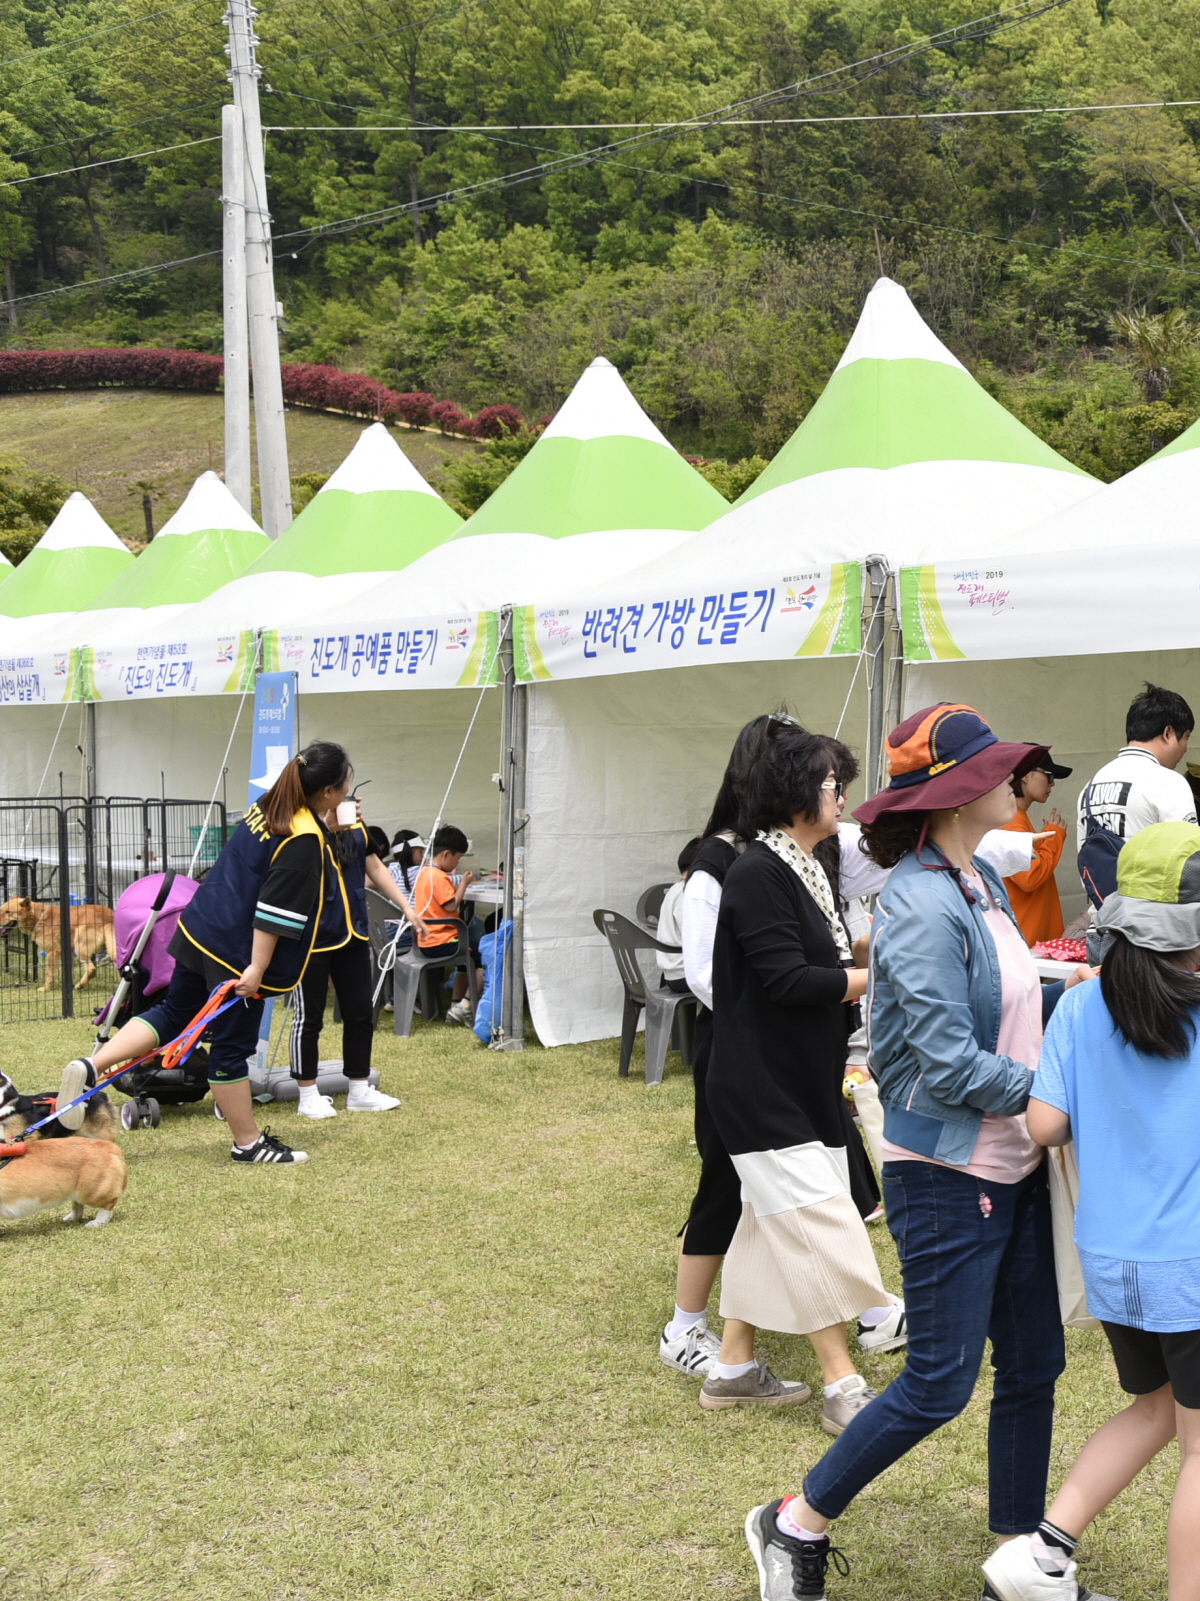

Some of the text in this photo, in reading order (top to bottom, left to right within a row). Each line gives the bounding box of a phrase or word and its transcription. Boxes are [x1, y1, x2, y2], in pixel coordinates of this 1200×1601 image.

[985, 570, 1004, 580] 2019
[582, 588, 776, 658] 반려견 가방 만들기
[310, 635, 350, 678] 진도개
[352, 632, 392, 678] 공예품
[395, 628, 439, 674] 만들기
[1082, 782, 1124, 807] LAVOR
